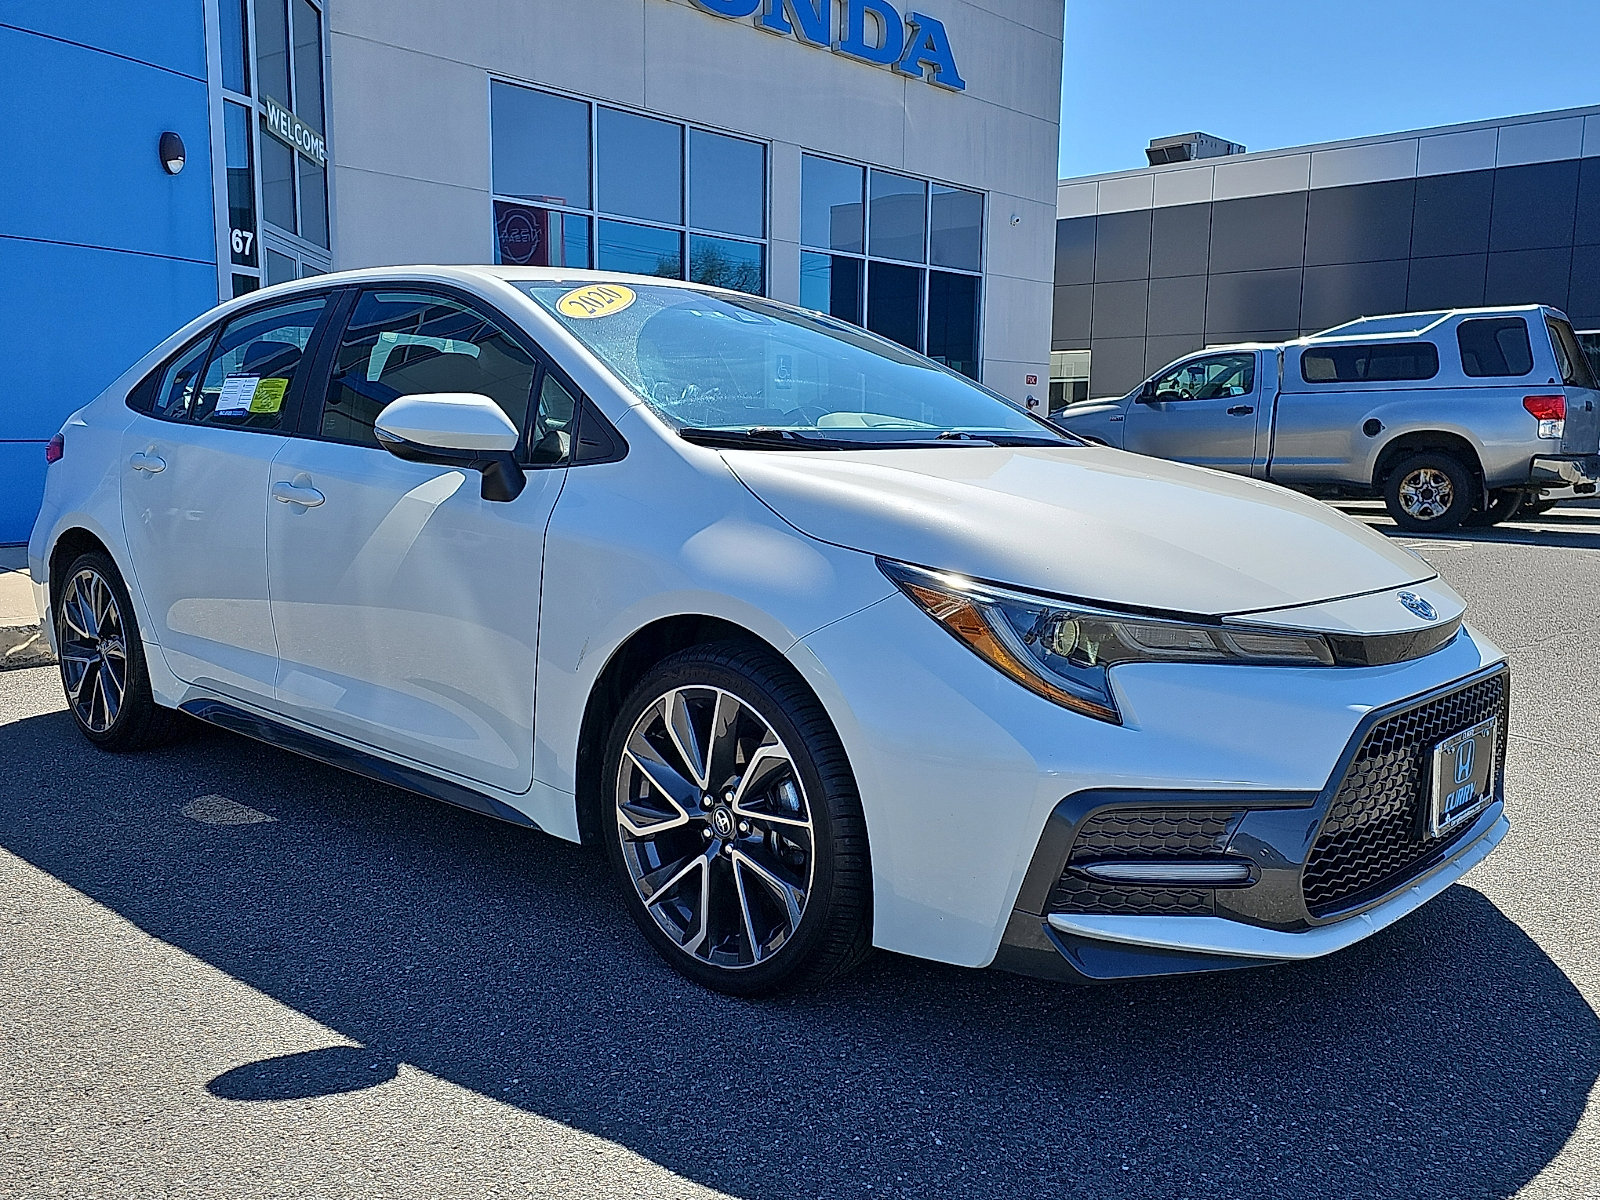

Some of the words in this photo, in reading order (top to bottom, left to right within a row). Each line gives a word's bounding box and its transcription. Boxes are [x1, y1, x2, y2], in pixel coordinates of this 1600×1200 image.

[688, 0, 966, 91] NDA
[266, 99, 325, 163] WELCOME
[228, 227, 254, 256] 67
[568, 287, 622, 314] 2020
[1445, 780, 1477, 813] CURRY
